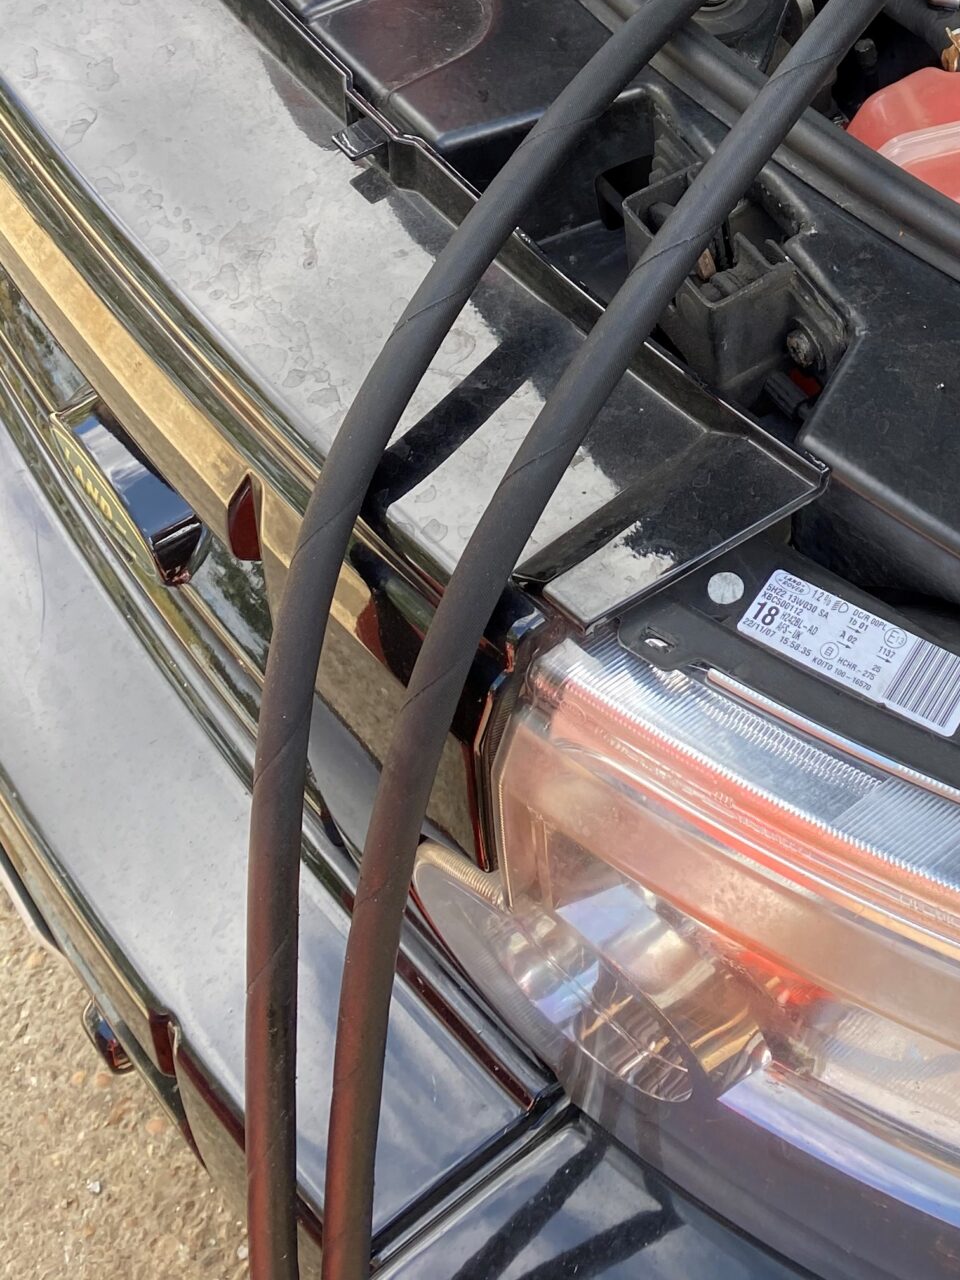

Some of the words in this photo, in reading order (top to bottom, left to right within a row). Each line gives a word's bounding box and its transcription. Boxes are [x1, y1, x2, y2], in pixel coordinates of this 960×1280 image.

[753, 601, 780, 626] 18
[761, 591, 803, 616] XBC500112
[766, 583, 787, 598] 5H22
[818, 609, 829, 619] SA
[742, 617, 777, 638] 22/11/07
[812, 657, 834, 671] KOITO
